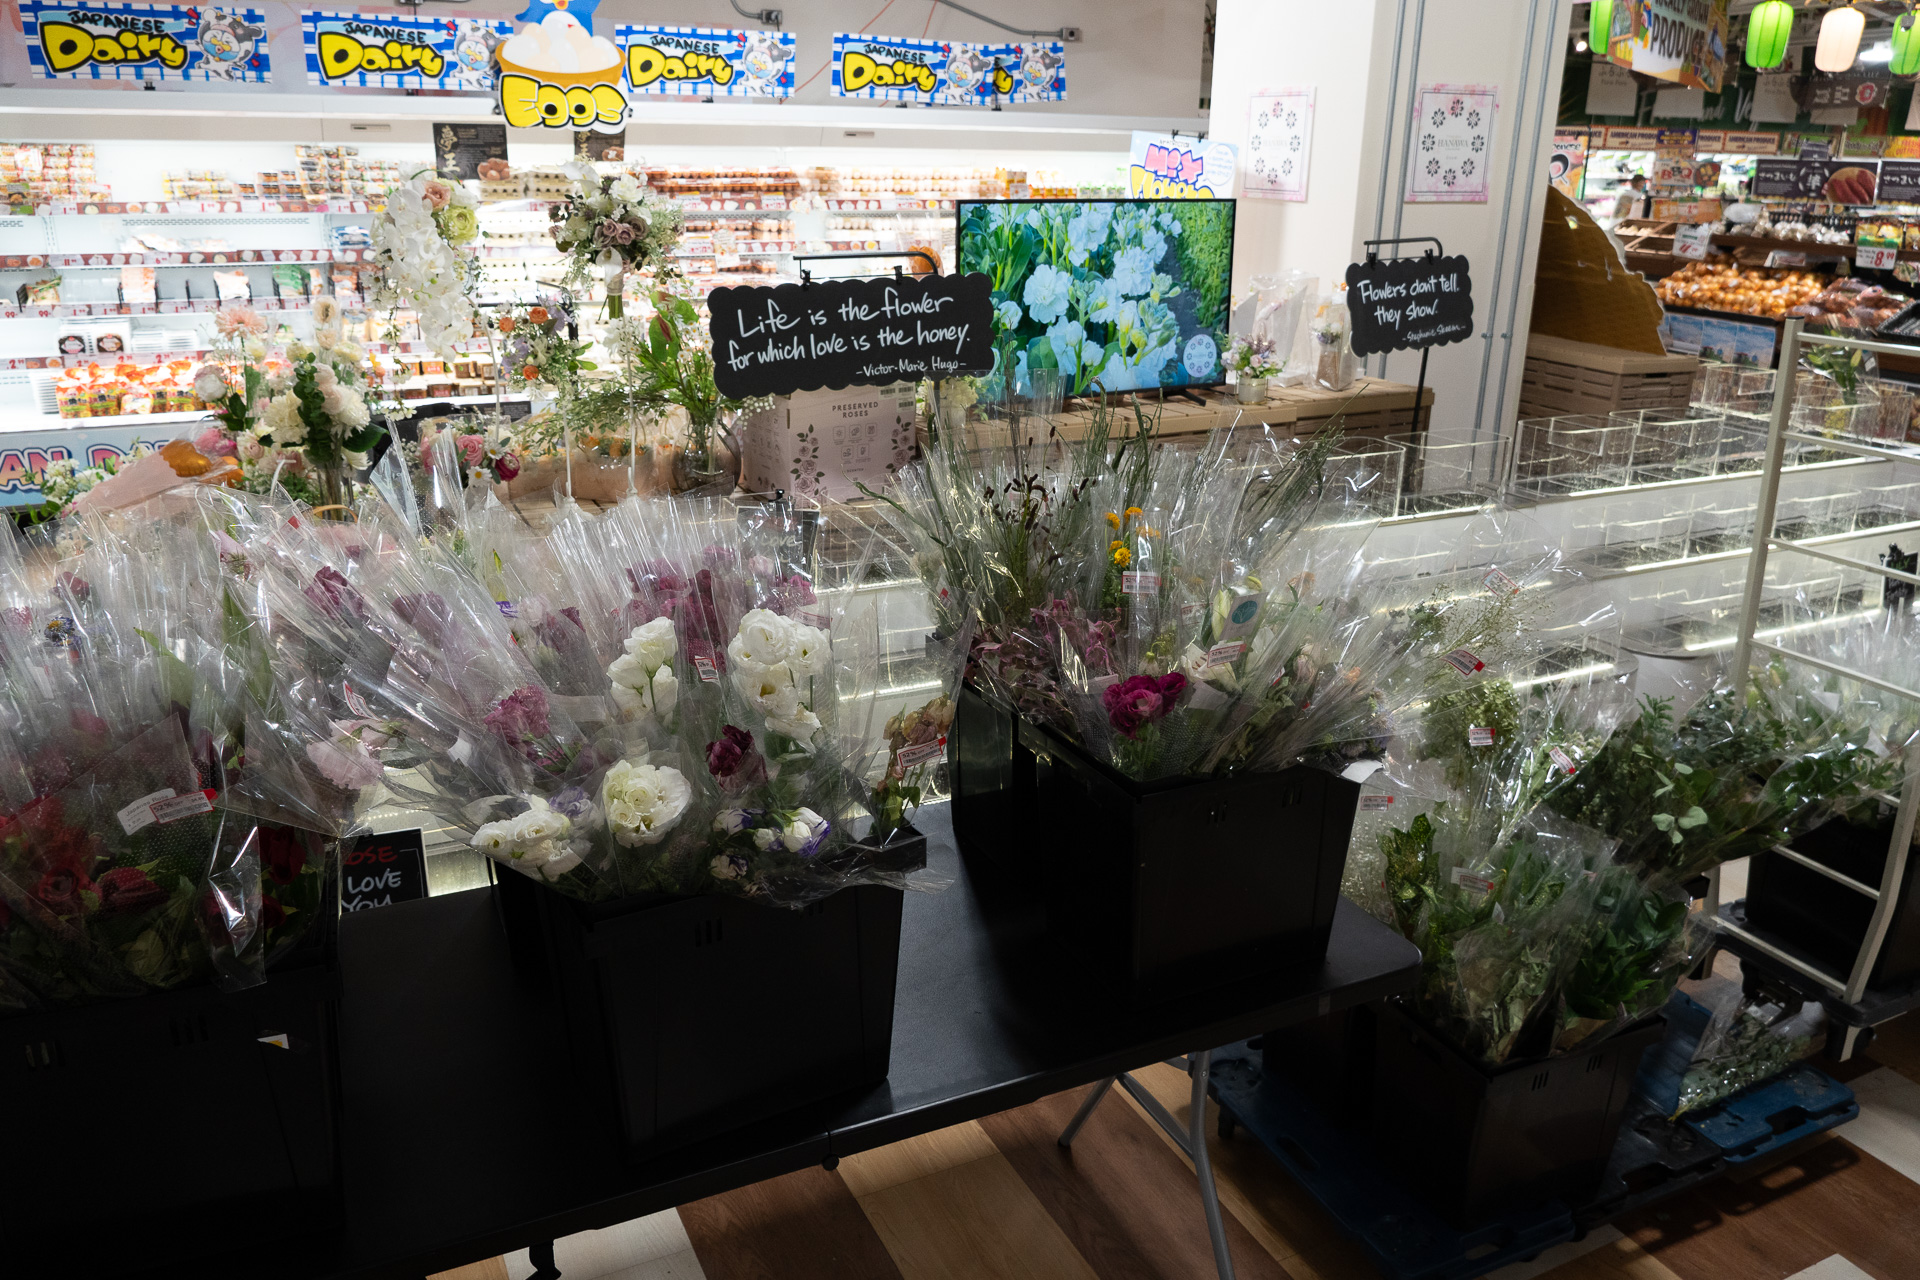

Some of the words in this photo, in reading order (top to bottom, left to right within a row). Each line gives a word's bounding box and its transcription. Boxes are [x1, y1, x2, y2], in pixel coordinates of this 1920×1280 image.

[68, 9, 166, 34] JAPANESE
[343, 21, 427, 46] JAPANESE
[39, 22, 188, 74] Dairy
[649, 33, 721, 56] JAPANESE
[1650, 12, 1706, 64] PRODUCE
[318, 31, 445, 81] Dairy
[864, 41, 928, 64] JAPANESE
[627, 42, 734, 89] Dairy
[841, 45, 939, 95] Dairy
[500, 73, 628, 131] Eggs
[1759, 171, 1797, 182] さつまいも
[1357, 279, 1406, 304] Flowers
[737, 299, 800, 338] Life
[808, 309, 827, 326] is
[838, 297, 881, 322] the
[881, 287, 953, 319] flower
[1374, 305, 1401, 330] they
[727, 340, 754, 372] for
[757, 335, 805, 363] which
[810, 333, 848, 359] love
[851, 335, 871, 351] is
[877, 326, 914, 347] the
[916, 320, 971, 354] honey.
[832, 401, 879, 412] PRESERVED
[842, 410, 869, 418] ROSES
[345, 845, 398, 866] OSE
[348, 868, 401, 894] LOVE
